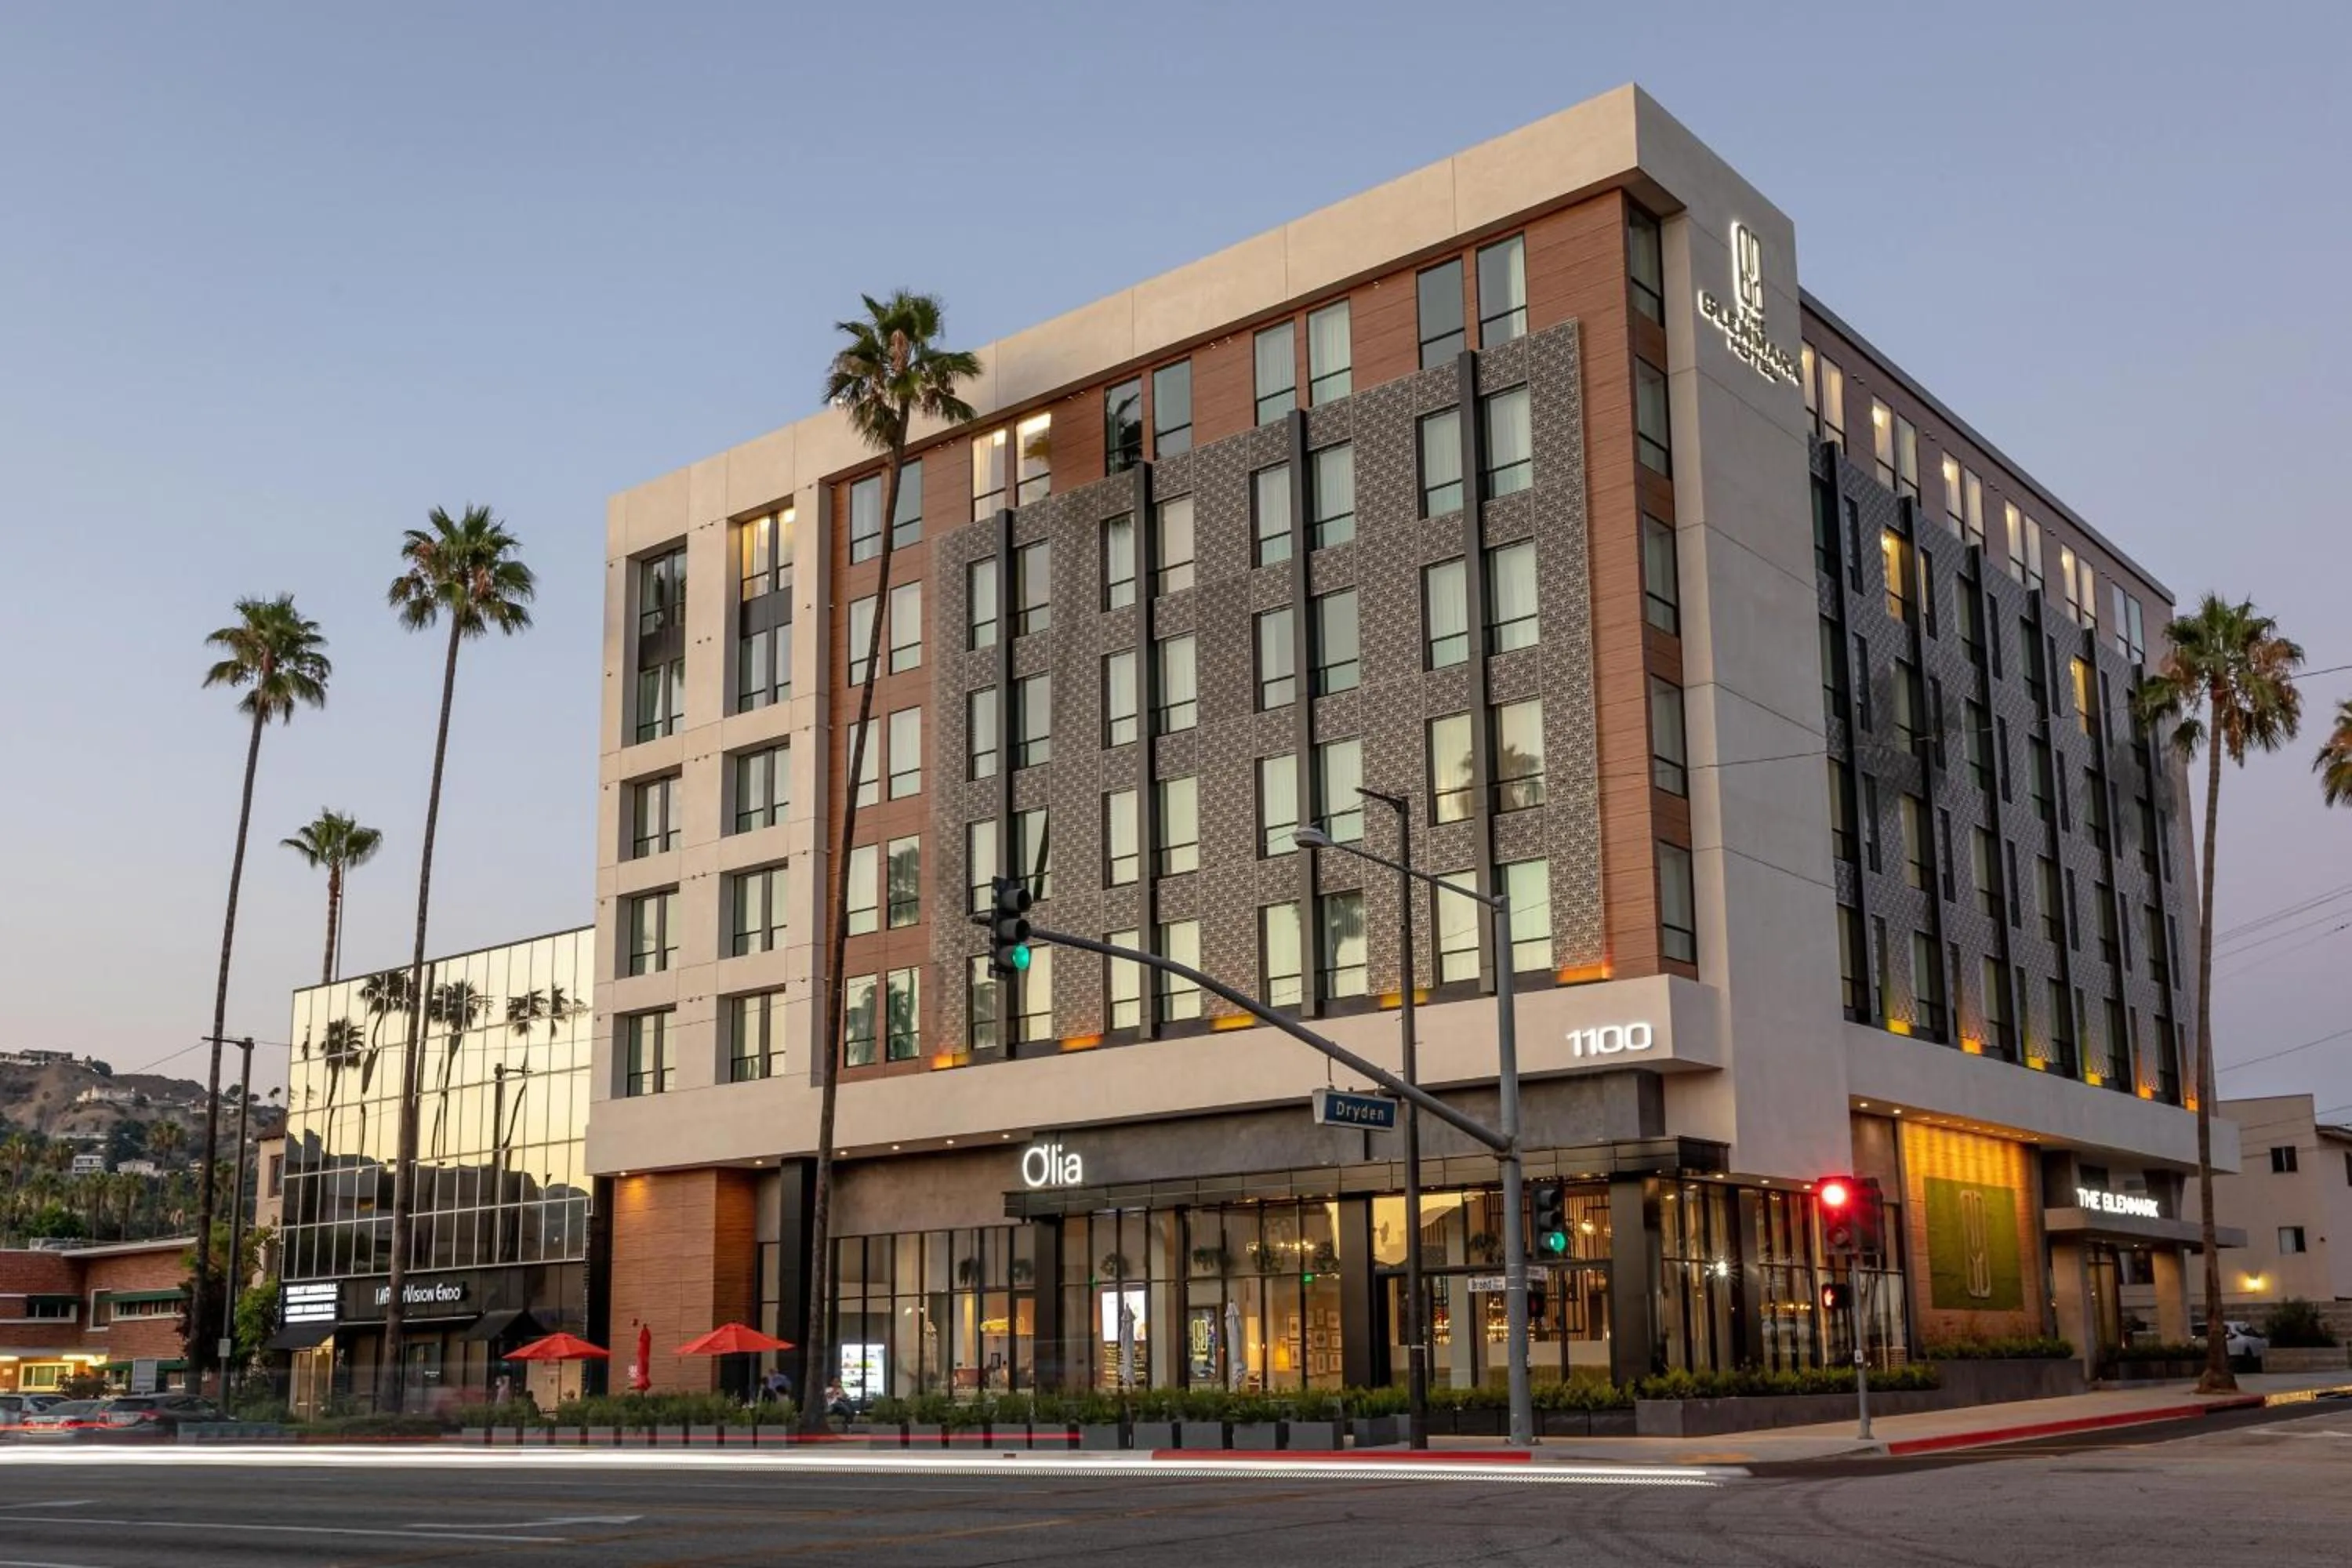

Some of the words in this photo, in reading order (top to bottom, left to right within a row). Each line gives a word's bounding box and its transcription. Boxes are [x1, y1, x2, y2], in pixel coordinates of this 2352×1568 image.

[1566, 1022, 1652, 1057] 1100
[1336, 1101, 1385, 1122] Dryden
[1022, 1143, 1083, 1188] Olia
[2076, 1188, 2100, 1210] THE
